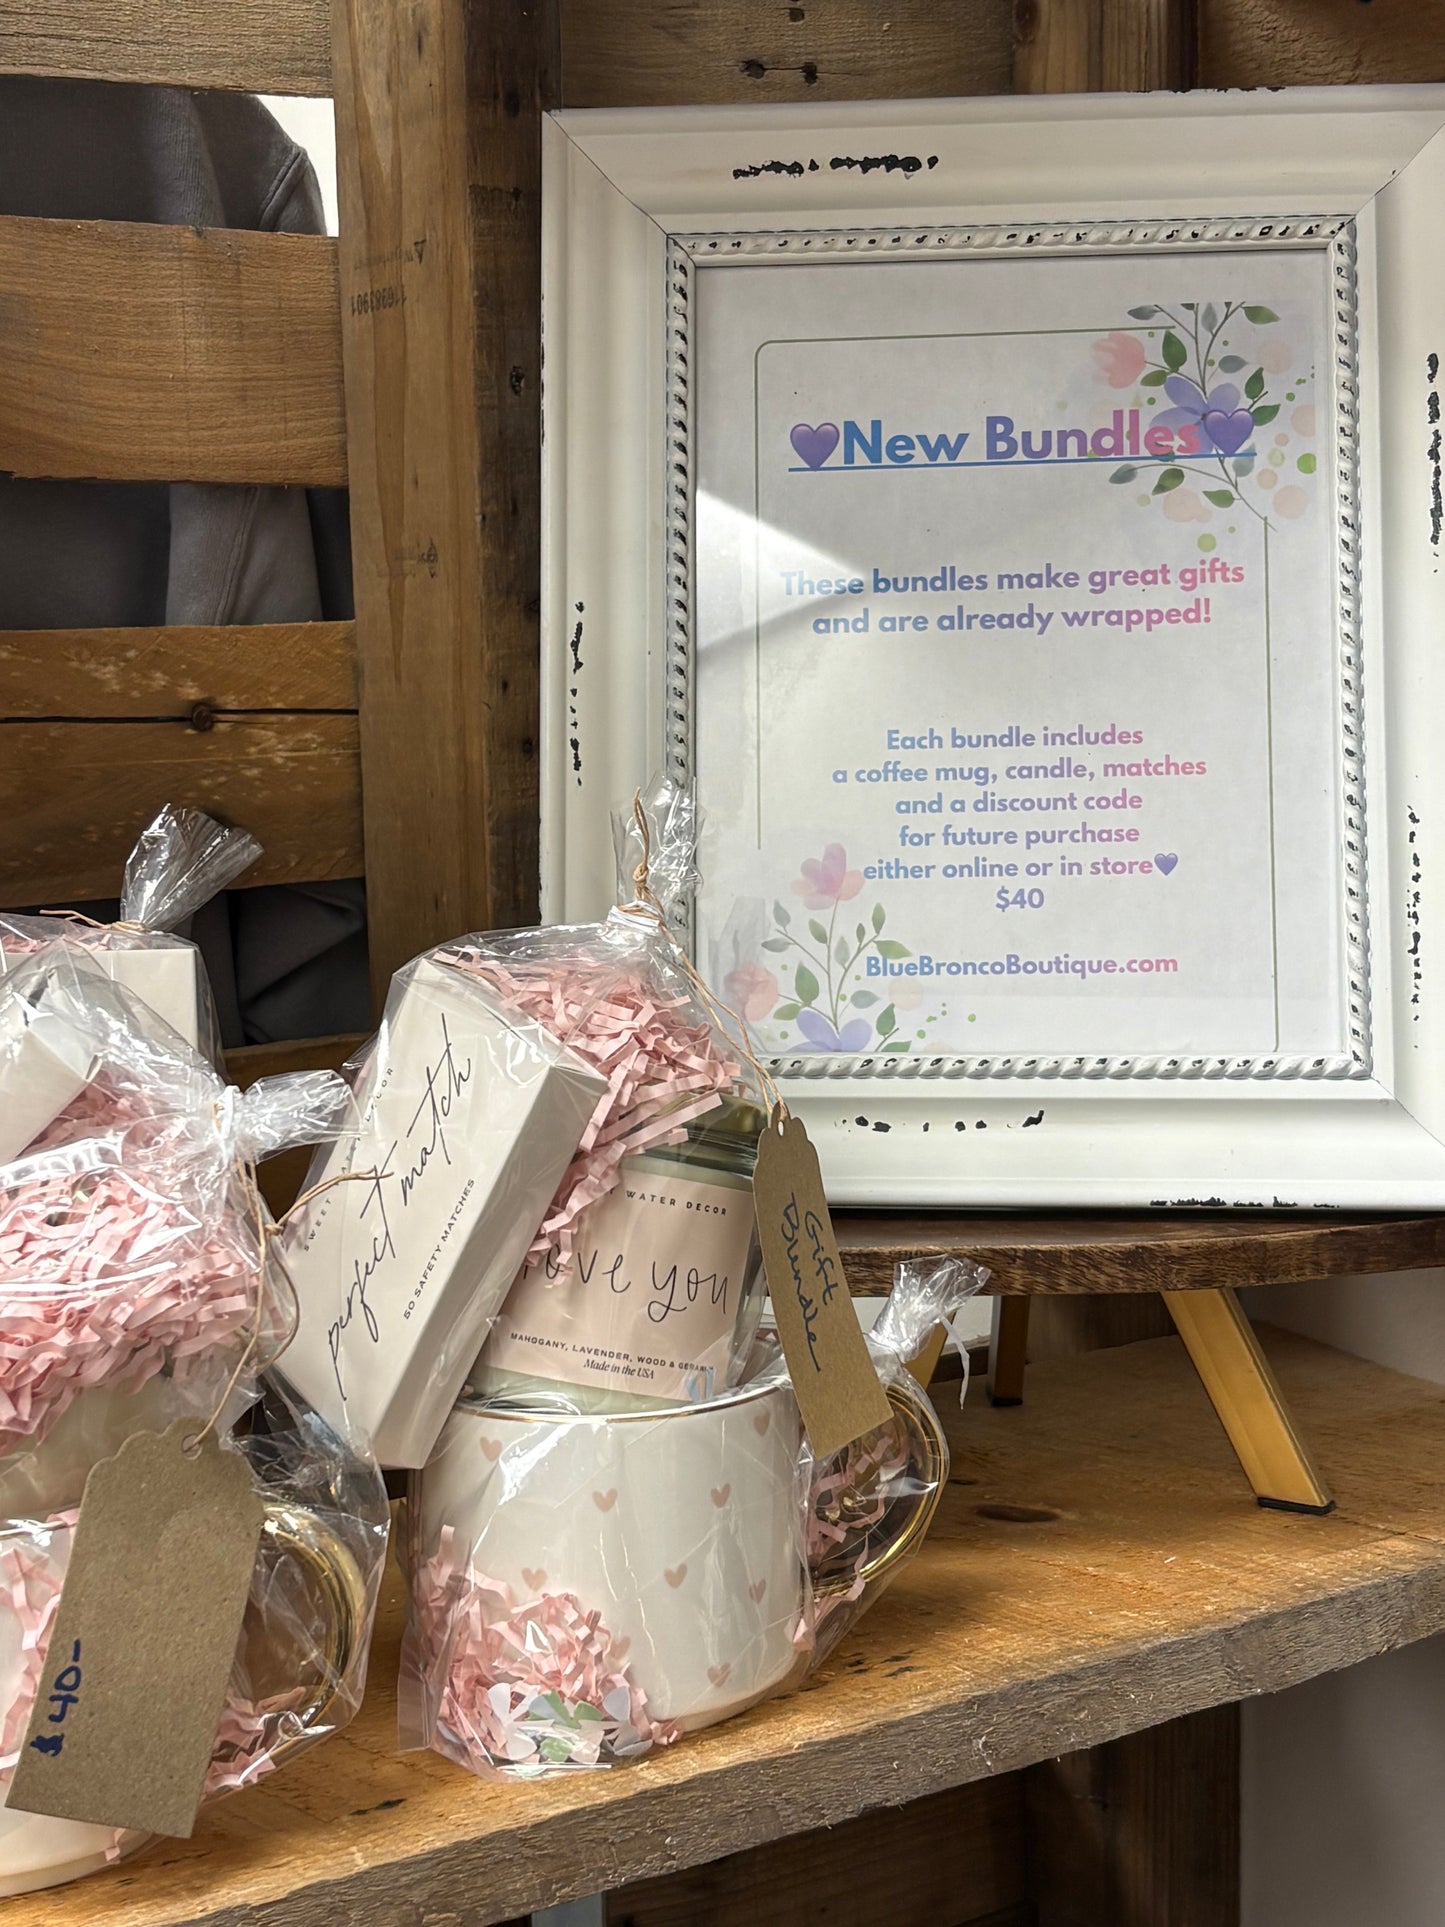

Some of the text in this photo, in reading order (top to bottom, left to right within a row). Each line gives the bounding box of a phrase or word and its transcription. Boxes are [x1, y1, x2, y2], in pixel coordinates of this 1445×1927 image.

[843, 408, 1200, 466] New Bundles
[780, 557, 1245, 595] These bundles make great gifts
[812, 598, 1211, 635] and are already wrapped!
[887, 724, 1143, 750] Each bundle includes
[832, 754, 1207, 786] a coffee mug, candle, matches
[895, 788, 1142, 814] and a discount code
[900, 822, 1140, 850] for future purchase
[863, 854, 1153, 880] either online or in store
[995, 887, 1045, 912] $40
[866, 953, 1178, 980] BlueBroncoBoutique.com
[327, 1012, 471, 1401] perfect match
[626, 1189, 676, 1206] WATER
[686, 1200, 727, 1216] DECOR
[304, 1199, 331, 1251] SWEET
[403, 1178, 475, 1320] 50 SAFETY MATCHES
[804, 1211, 840, 1306] Gift
[523, 1243, 728, 1322] ove you
[510, 1332, 569, 1351] MAHOGANY,
[572, 1344, 633, 1362] LAVENDER,
[637, 1355, 666, 1367] WOOD
[583, 1358, 655, 1379] Made in the USA
